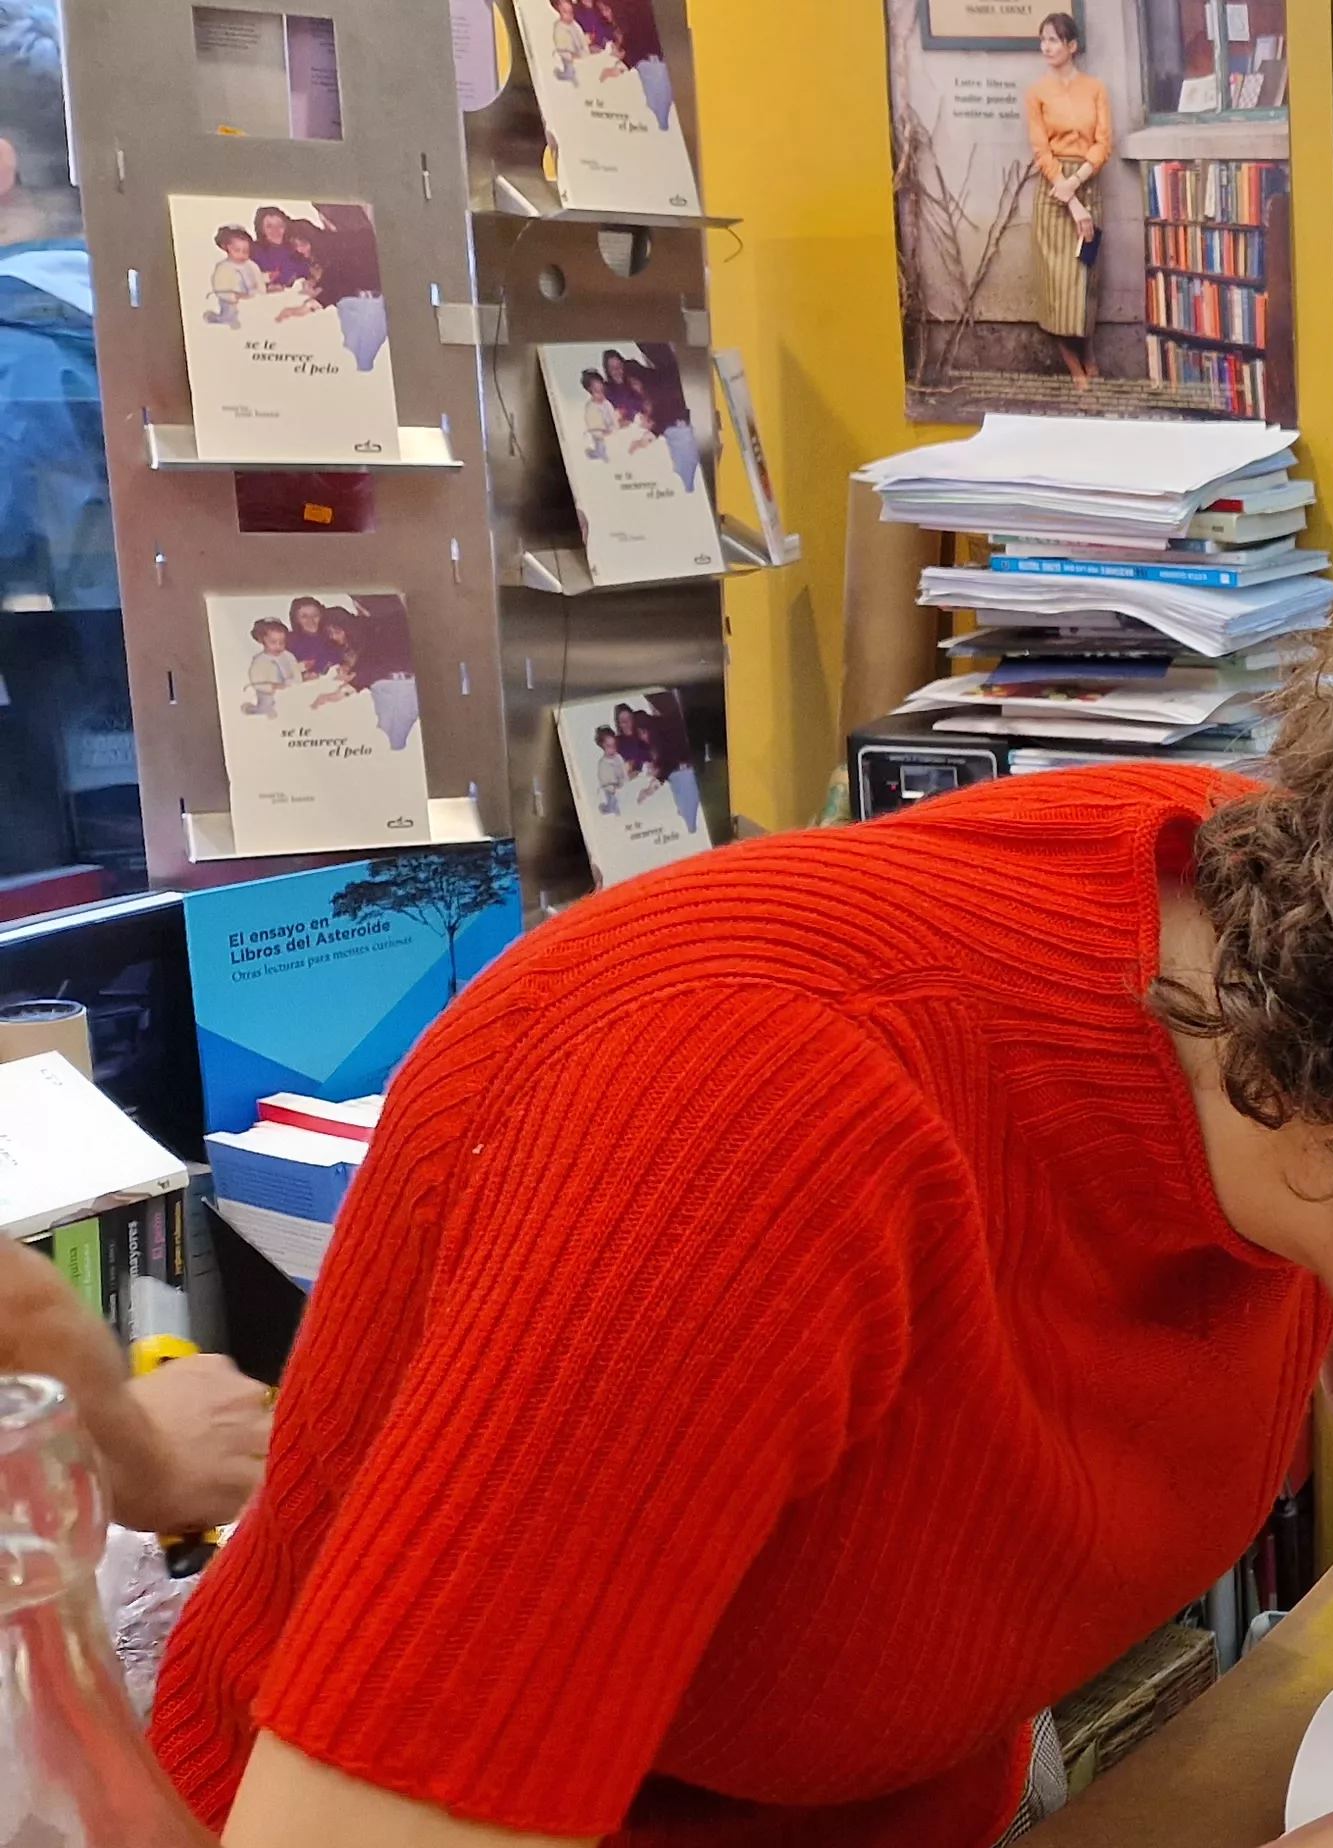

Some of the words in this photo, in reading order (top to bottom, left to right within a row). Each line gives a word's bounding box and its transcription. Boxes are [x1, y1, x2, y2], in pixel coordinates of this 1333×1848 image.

[252, 352, 314, 362] oscurece
[294, 363, 306, 373] el
[310, 363, 339, 376] pelo
[288, 737, 348, 748] oscurece
[329, 746, 340, 757] el
[344, 745, 373, 758] pelo
[229, 932, 244, 948] El
[250, 922, 305, 943] ensayo
[310, 917, 329, 930] en
[230, 946, 281, 965] Libros
[286, 935, 310, 952] del
[316, 920, 390, 946] Asteroide
[232, 968, 261, 982] Otras
[264, 959, 305, 975] lecturas
[307, 953, 330, 969] para
